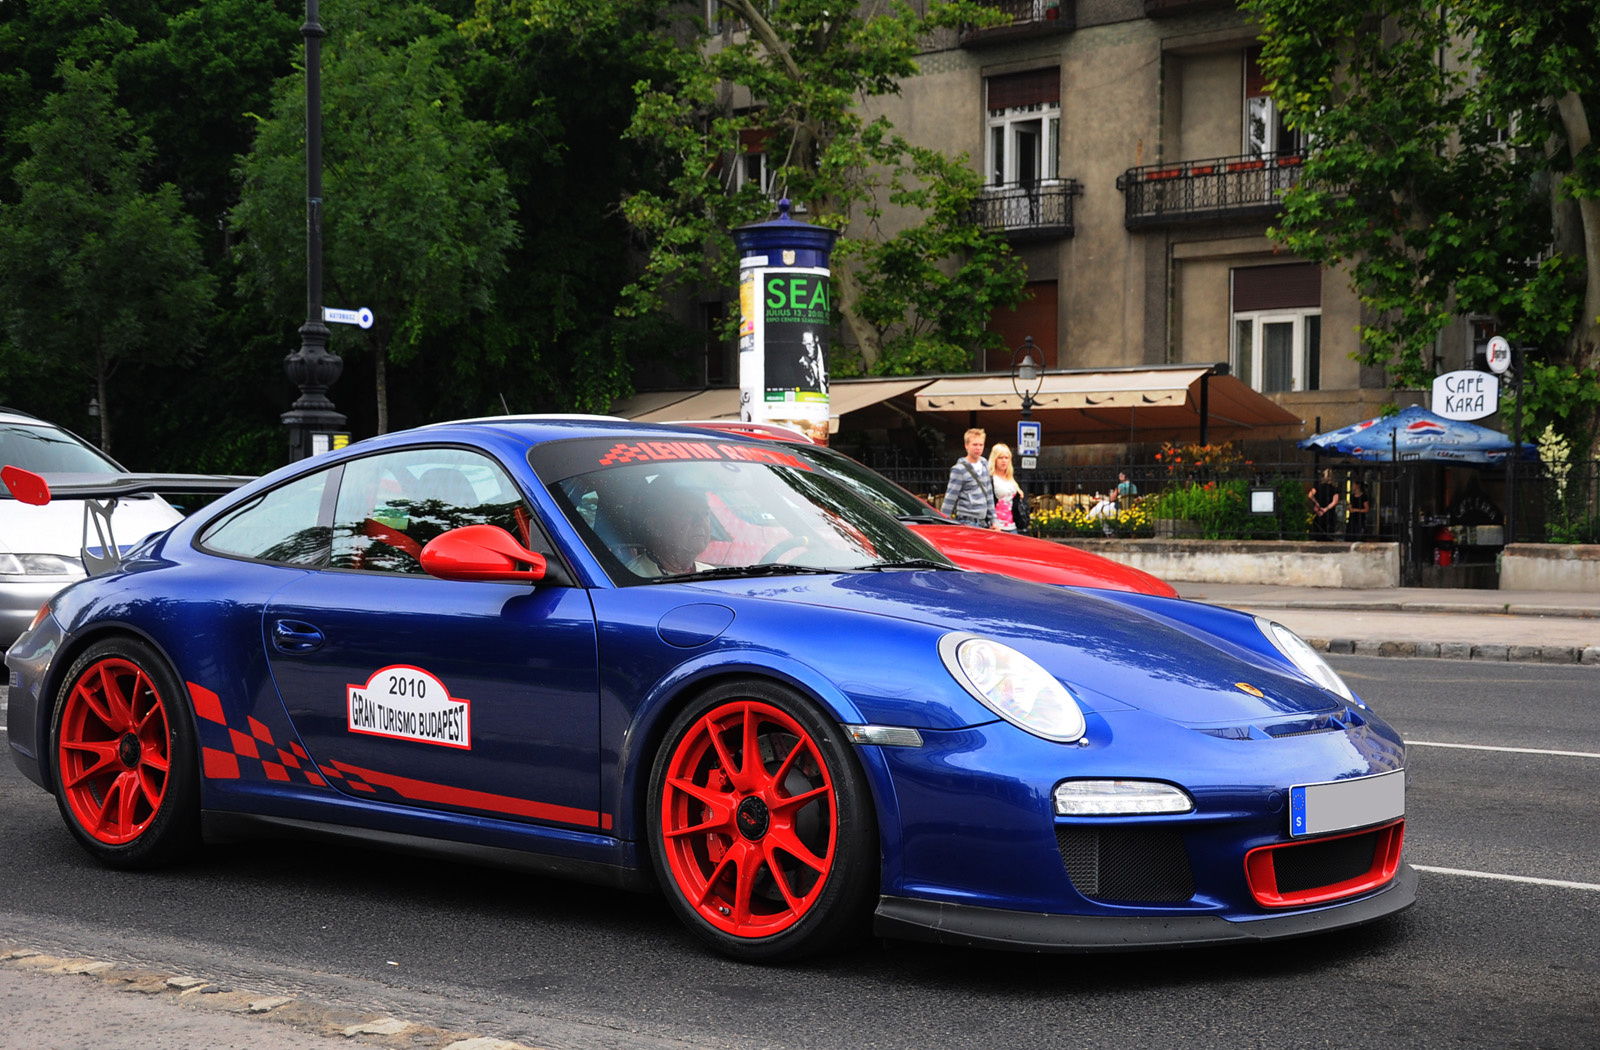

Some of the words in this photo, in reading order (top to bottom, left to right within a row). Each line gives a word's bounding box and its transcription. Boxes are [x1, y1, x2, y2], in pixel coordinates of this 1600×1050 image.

[1445, 374, 1484, 393] CAFÉ
[1445, 395, 1485, 413] KARA
[389, 676, 426, 698] 2010
[352, 691, 376, 728] GRAN
[377, 704, 417, 735] TURISMO
[419, 705, 465, 742] BUDAPEST
[1296, 816, 1302, 827] S
